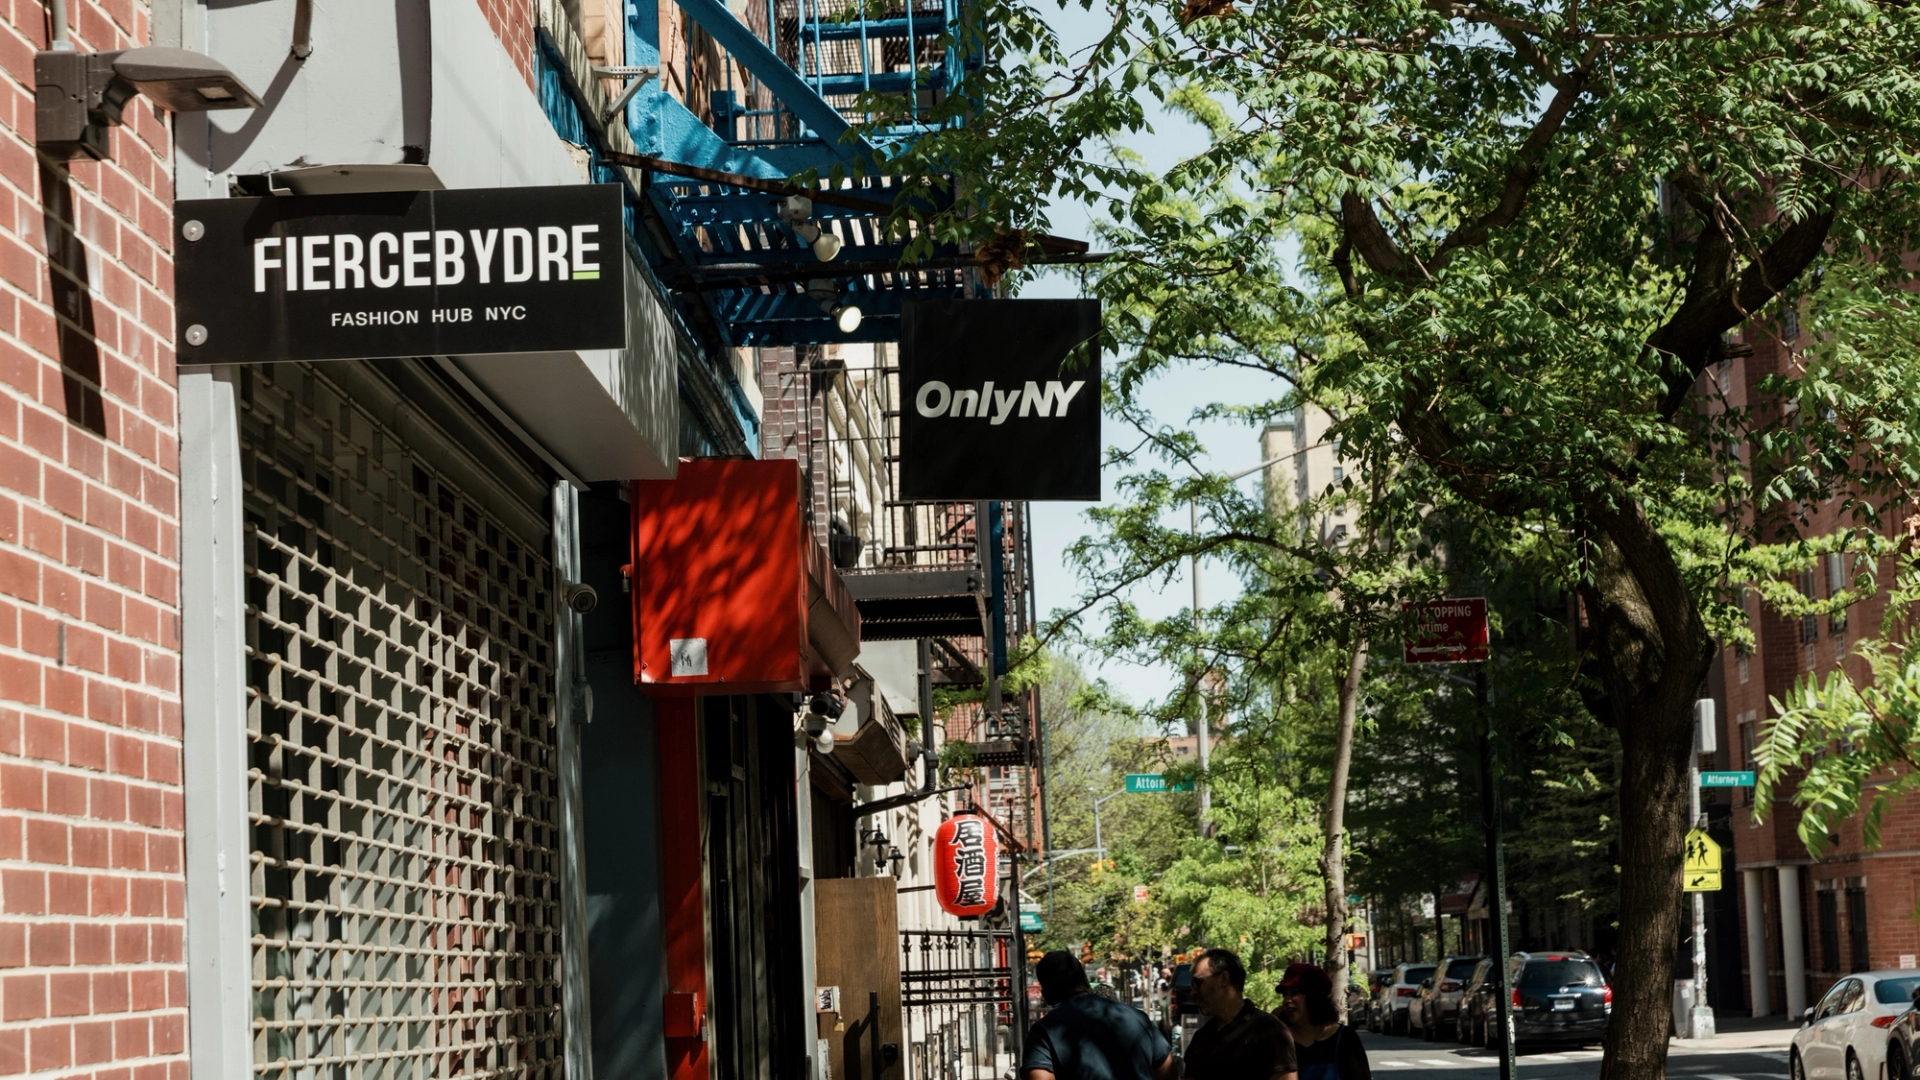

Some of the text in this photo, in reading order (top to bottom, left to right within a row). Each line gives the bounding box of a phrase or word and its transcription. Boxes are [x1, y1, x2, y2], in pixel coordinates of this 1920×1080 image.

[254, 224, 600, 292] FIERCEBYDRE
[331, 305, 527, 327] FASHION HUB NYC
[915, 380, 1086, 425] OnlyNY
[1707, 775, 1739, 786] Attorney
[949, 819, 987, 907] 居酒屋
